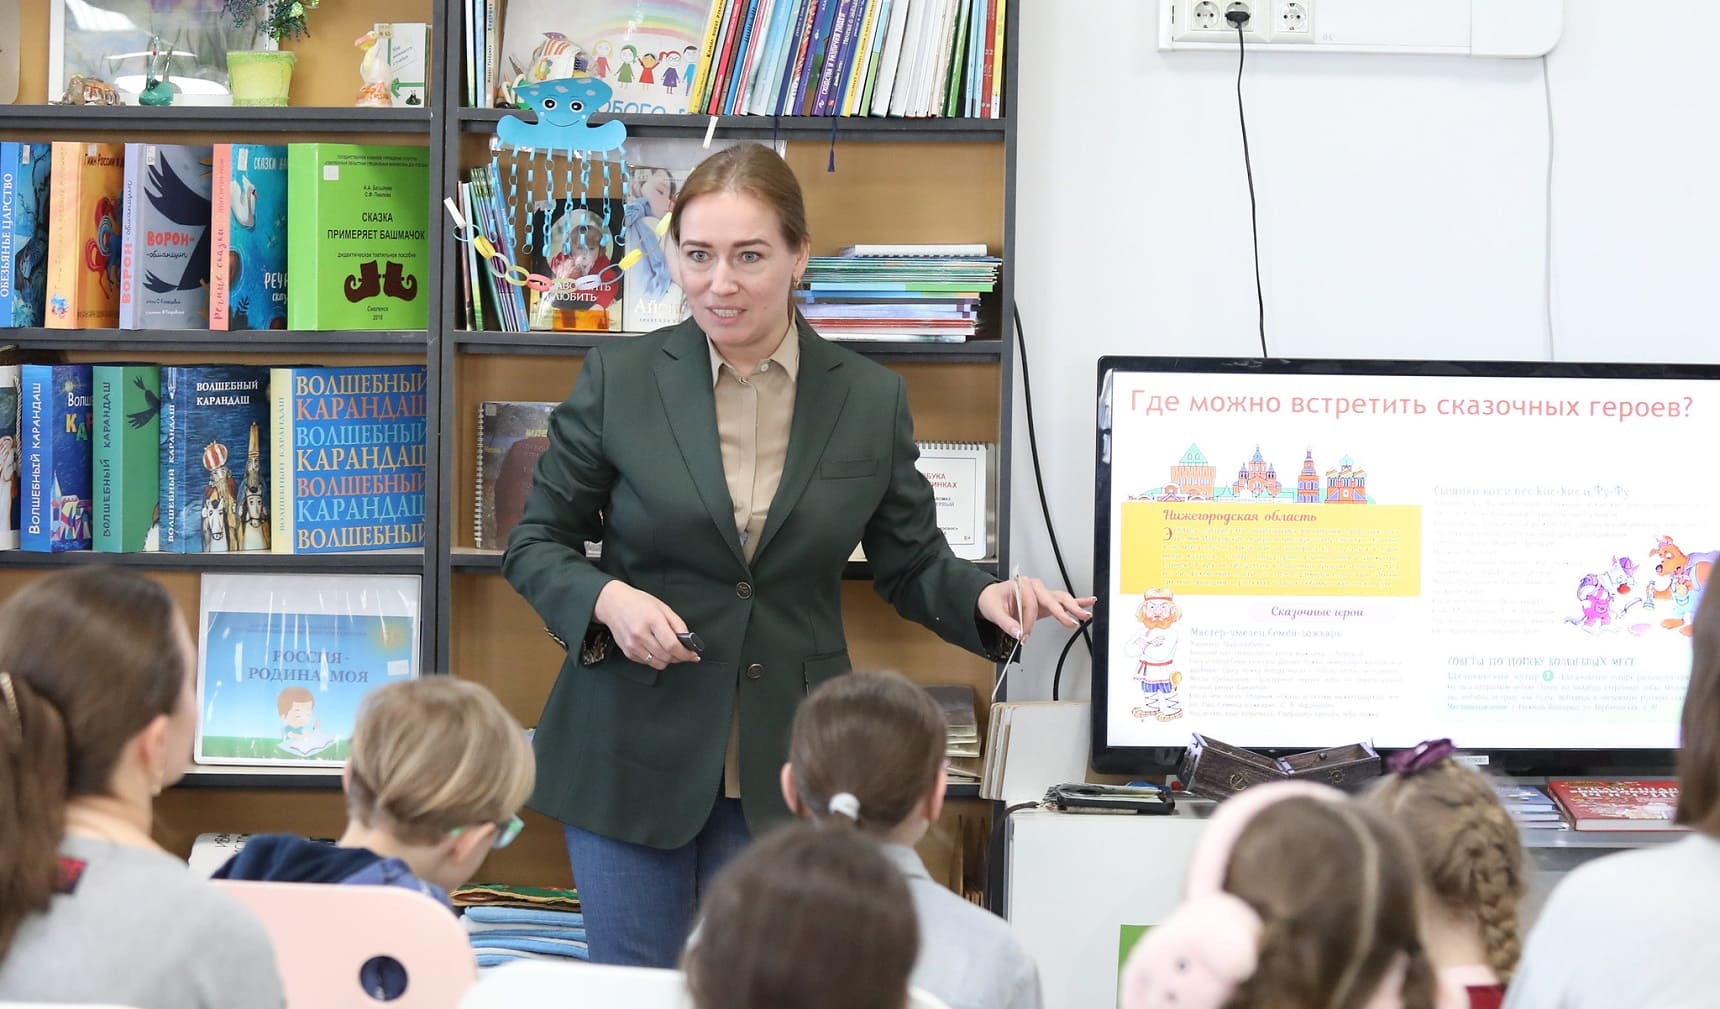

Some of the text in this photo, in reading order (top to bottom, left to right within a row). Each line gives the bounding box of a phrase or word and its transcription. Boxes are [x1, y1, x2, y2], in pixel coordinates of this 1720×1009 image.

[4, 173, 13, 230] ЦАРСТВО
[361, 212, 394, 223] СКАЗКА
[327, 230, 425, 241] ПРИМЕРЯЕТ БАШМАЧОК
[196, 379, 259, 392] ВОЛШЕБНЫЙ
[196, 395, 250, 407] КАРАНДАШ
[1131, 389, 1693, 422] Где можно встретить сказочных героев?
[32, 383, 42, 449] КАРАНДАШ
[101, 382, 111, 537] ВОЛШЕБНЫЙ КАРАНДАШ
[167, 404, 175, 544] ВОЛШЕБНЫЙ КАРАНДАШ
[1162, 508, 1317, 525] Нижегородская область
[1271, 606, 1364, 620] Сказочные герои
[248, 666, 369, 684] РОДИНА МОЯ
